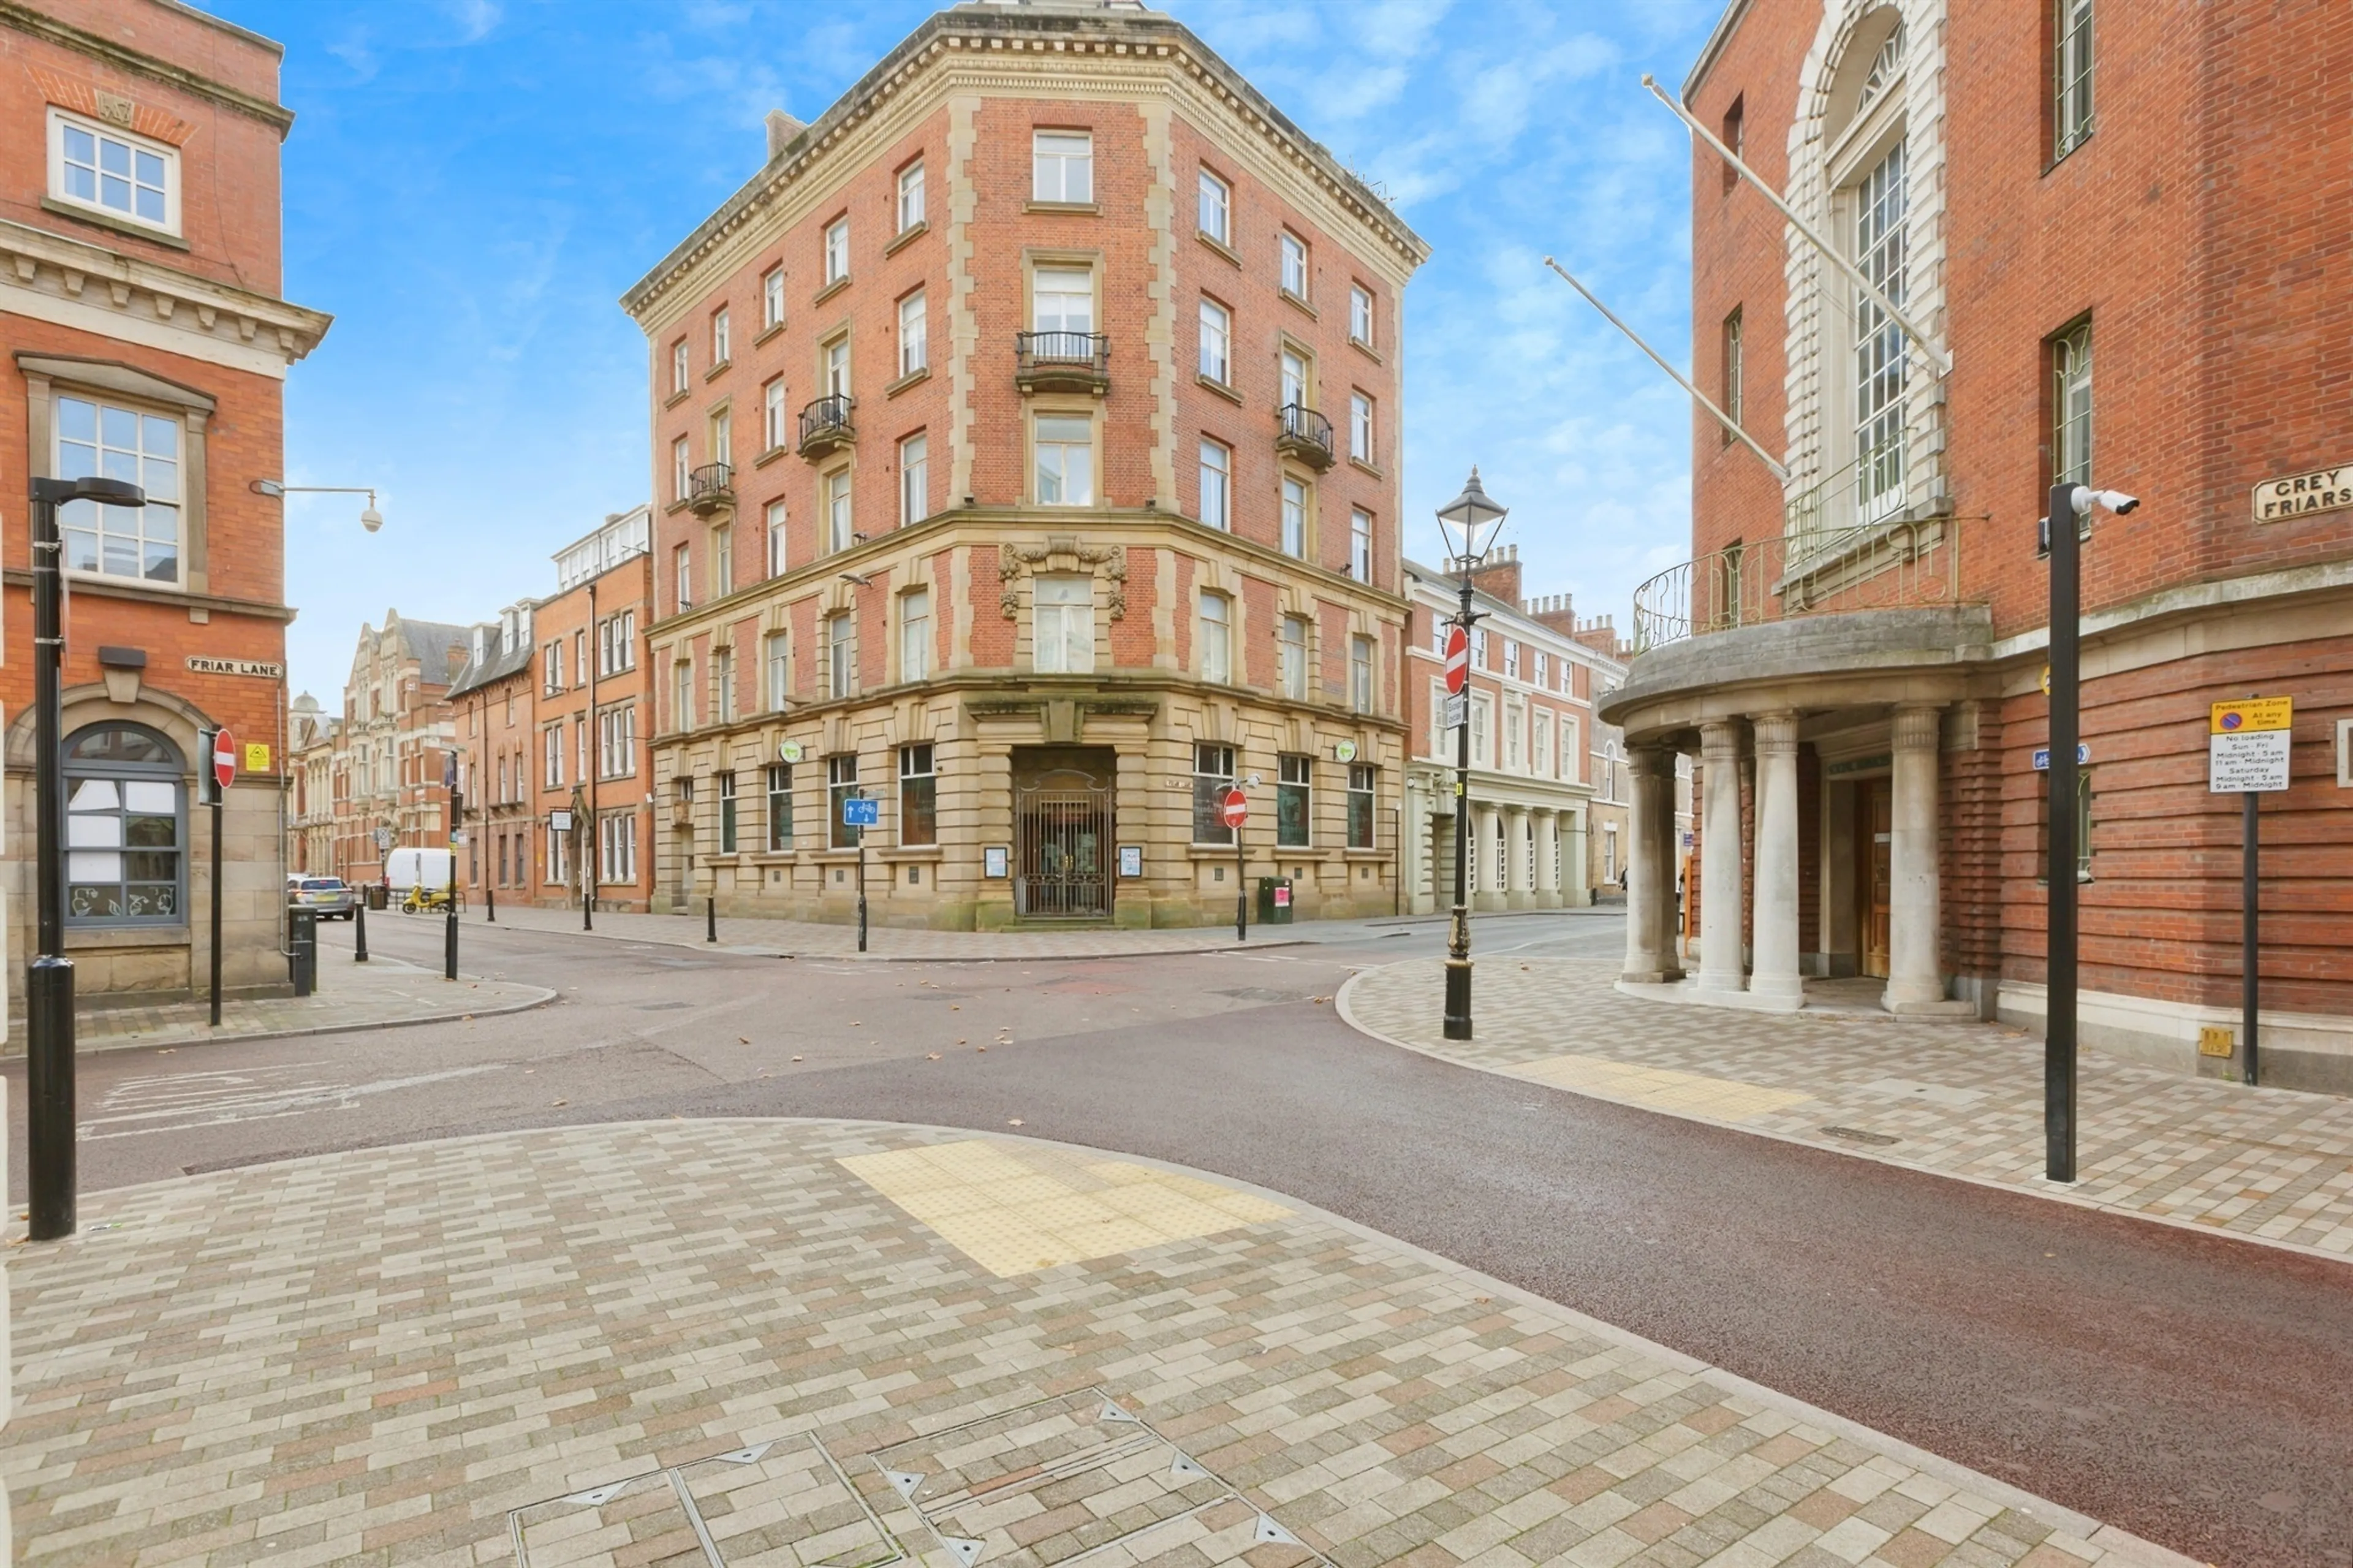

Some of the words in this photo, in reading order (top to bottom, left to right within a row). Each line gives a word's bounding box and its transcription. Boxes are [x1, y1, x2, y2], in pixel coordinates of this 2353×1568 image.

[2264, 488, 2352, 518] FRIARS
[191, 659, 233, 673] FRIAR
[241, 664, 278, 676] LANE
[2215, 702, 2263, 710] Pedestrian
